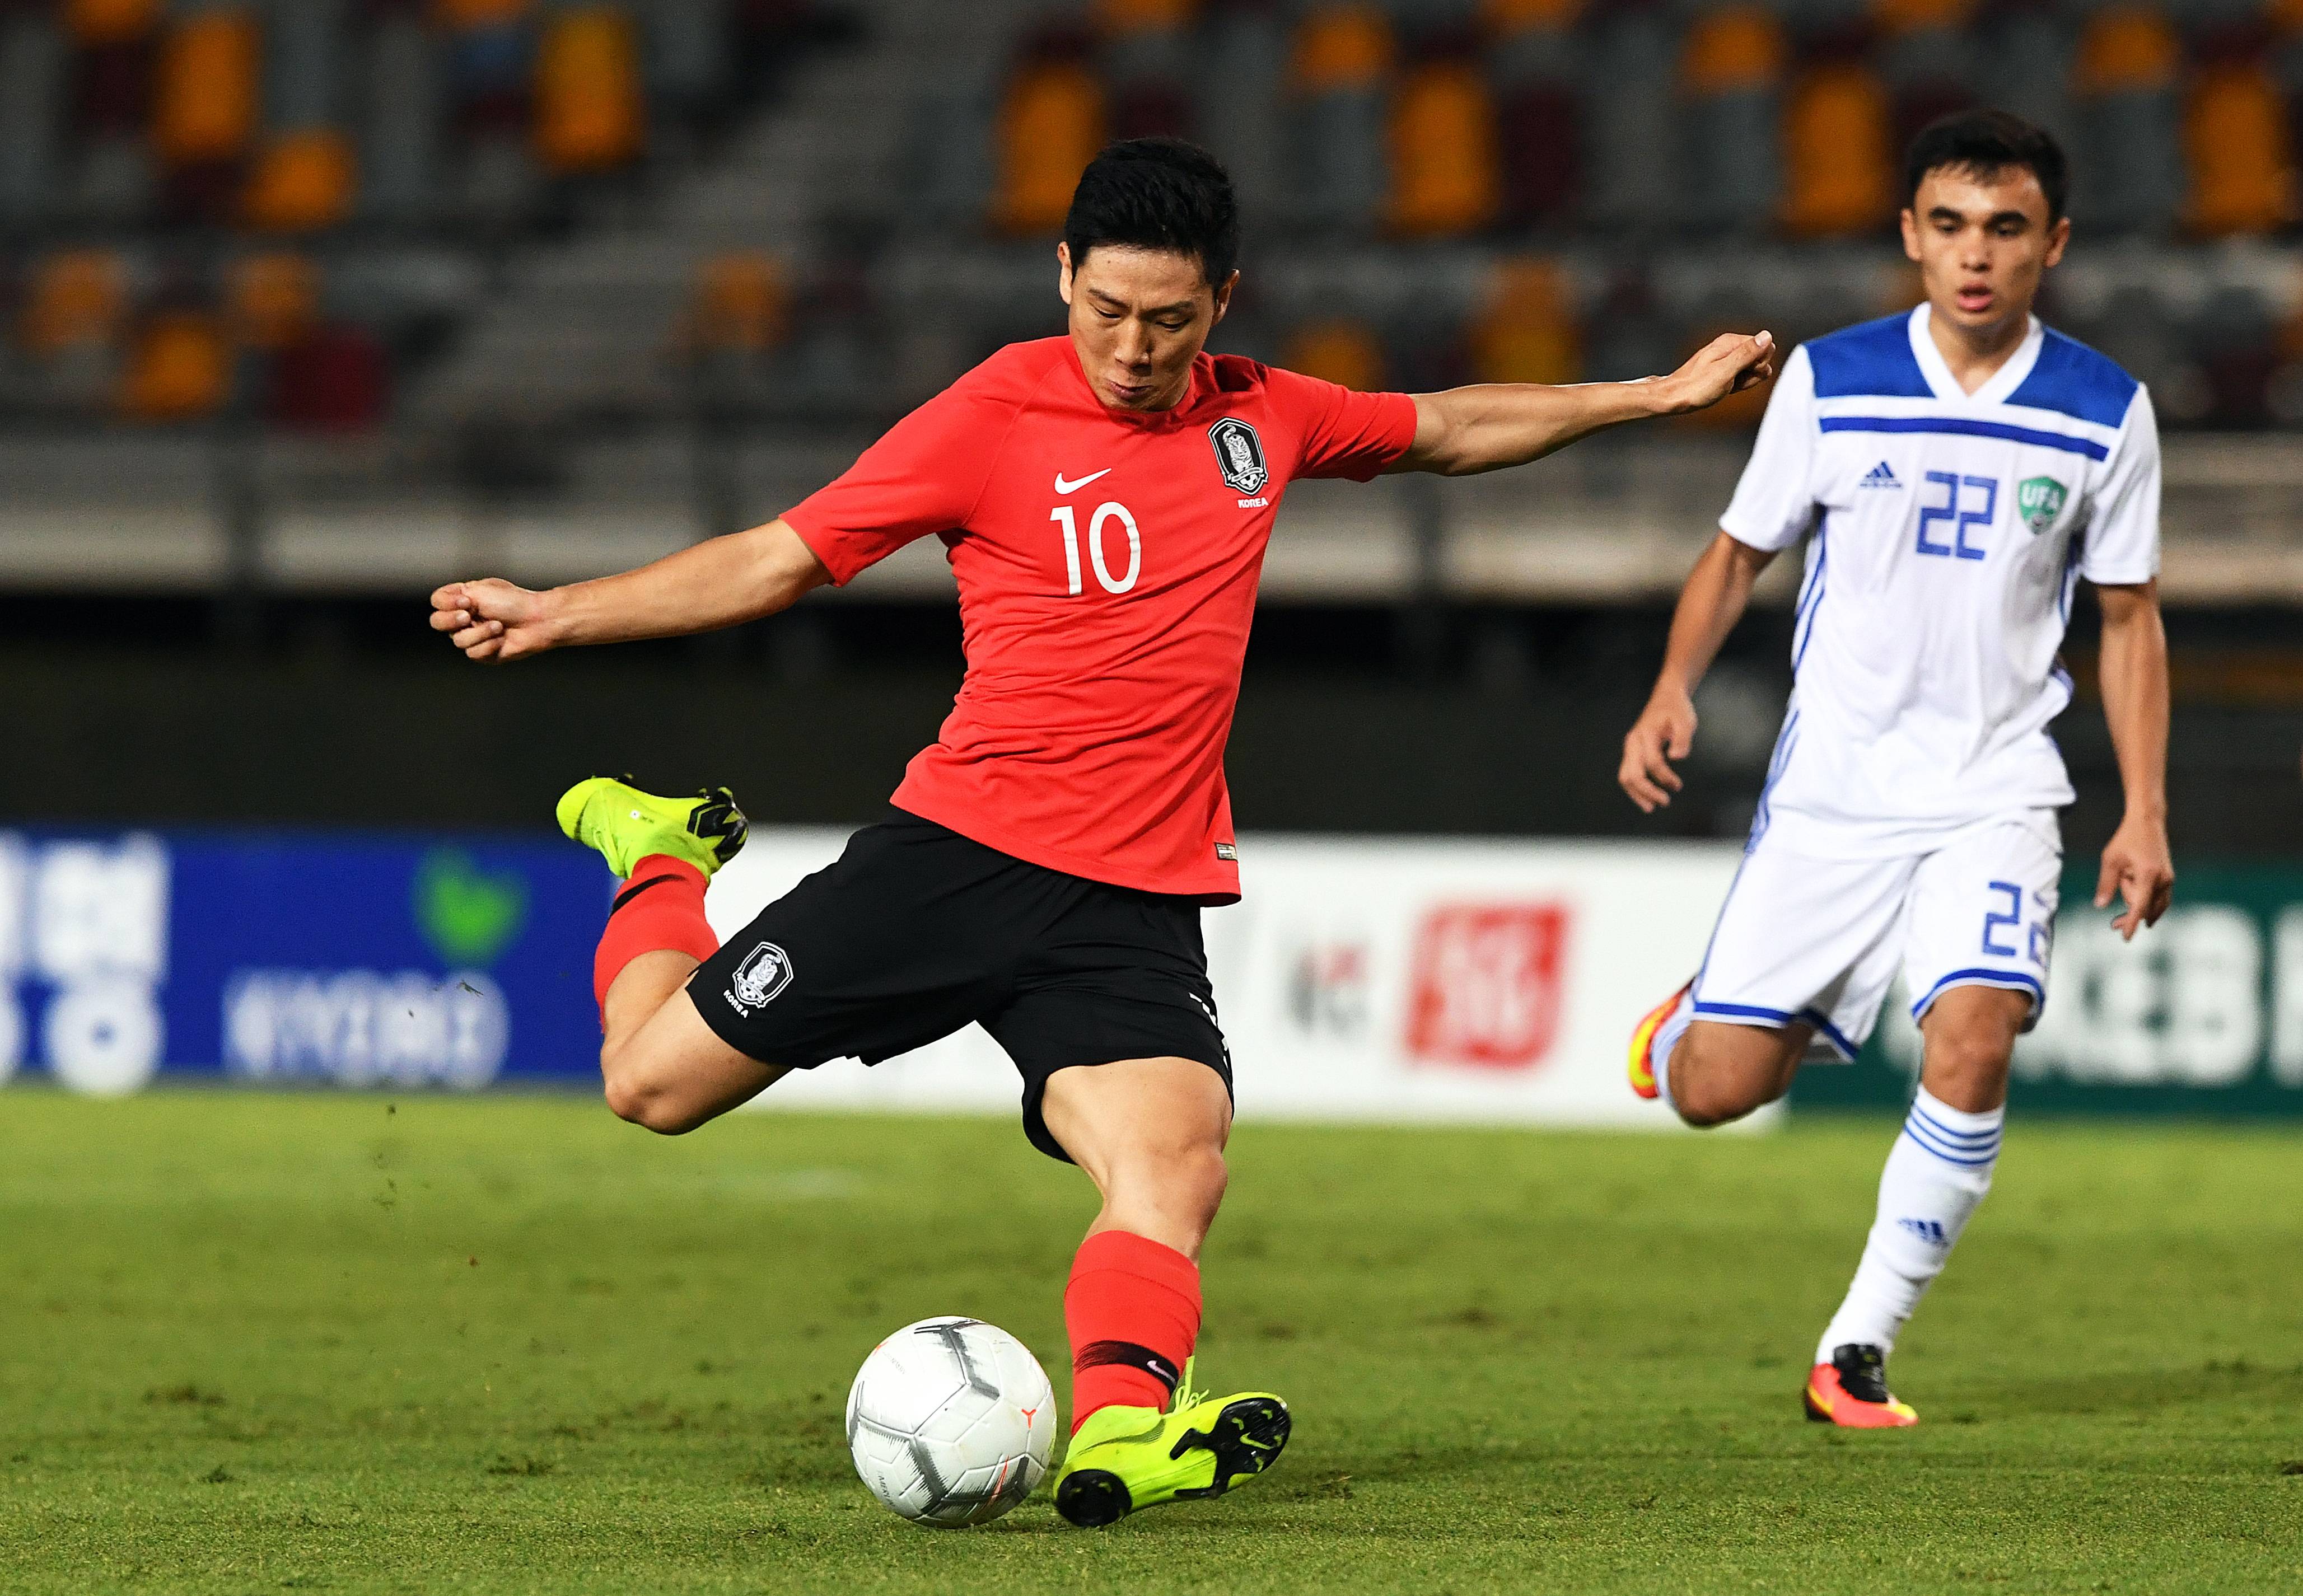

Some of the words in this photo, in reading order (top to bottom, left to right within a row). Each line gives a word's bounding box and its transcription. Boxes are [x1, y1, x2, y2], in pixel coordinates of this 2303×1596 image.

[1237, 497, 1269, 508] KOREA
[2022, 483, 2059, 509] UFA
[1917, 471, 1998, 559] 22
[1049, 501, 1141, 595] 10
[723, 989, 749, 1018] KOREA
